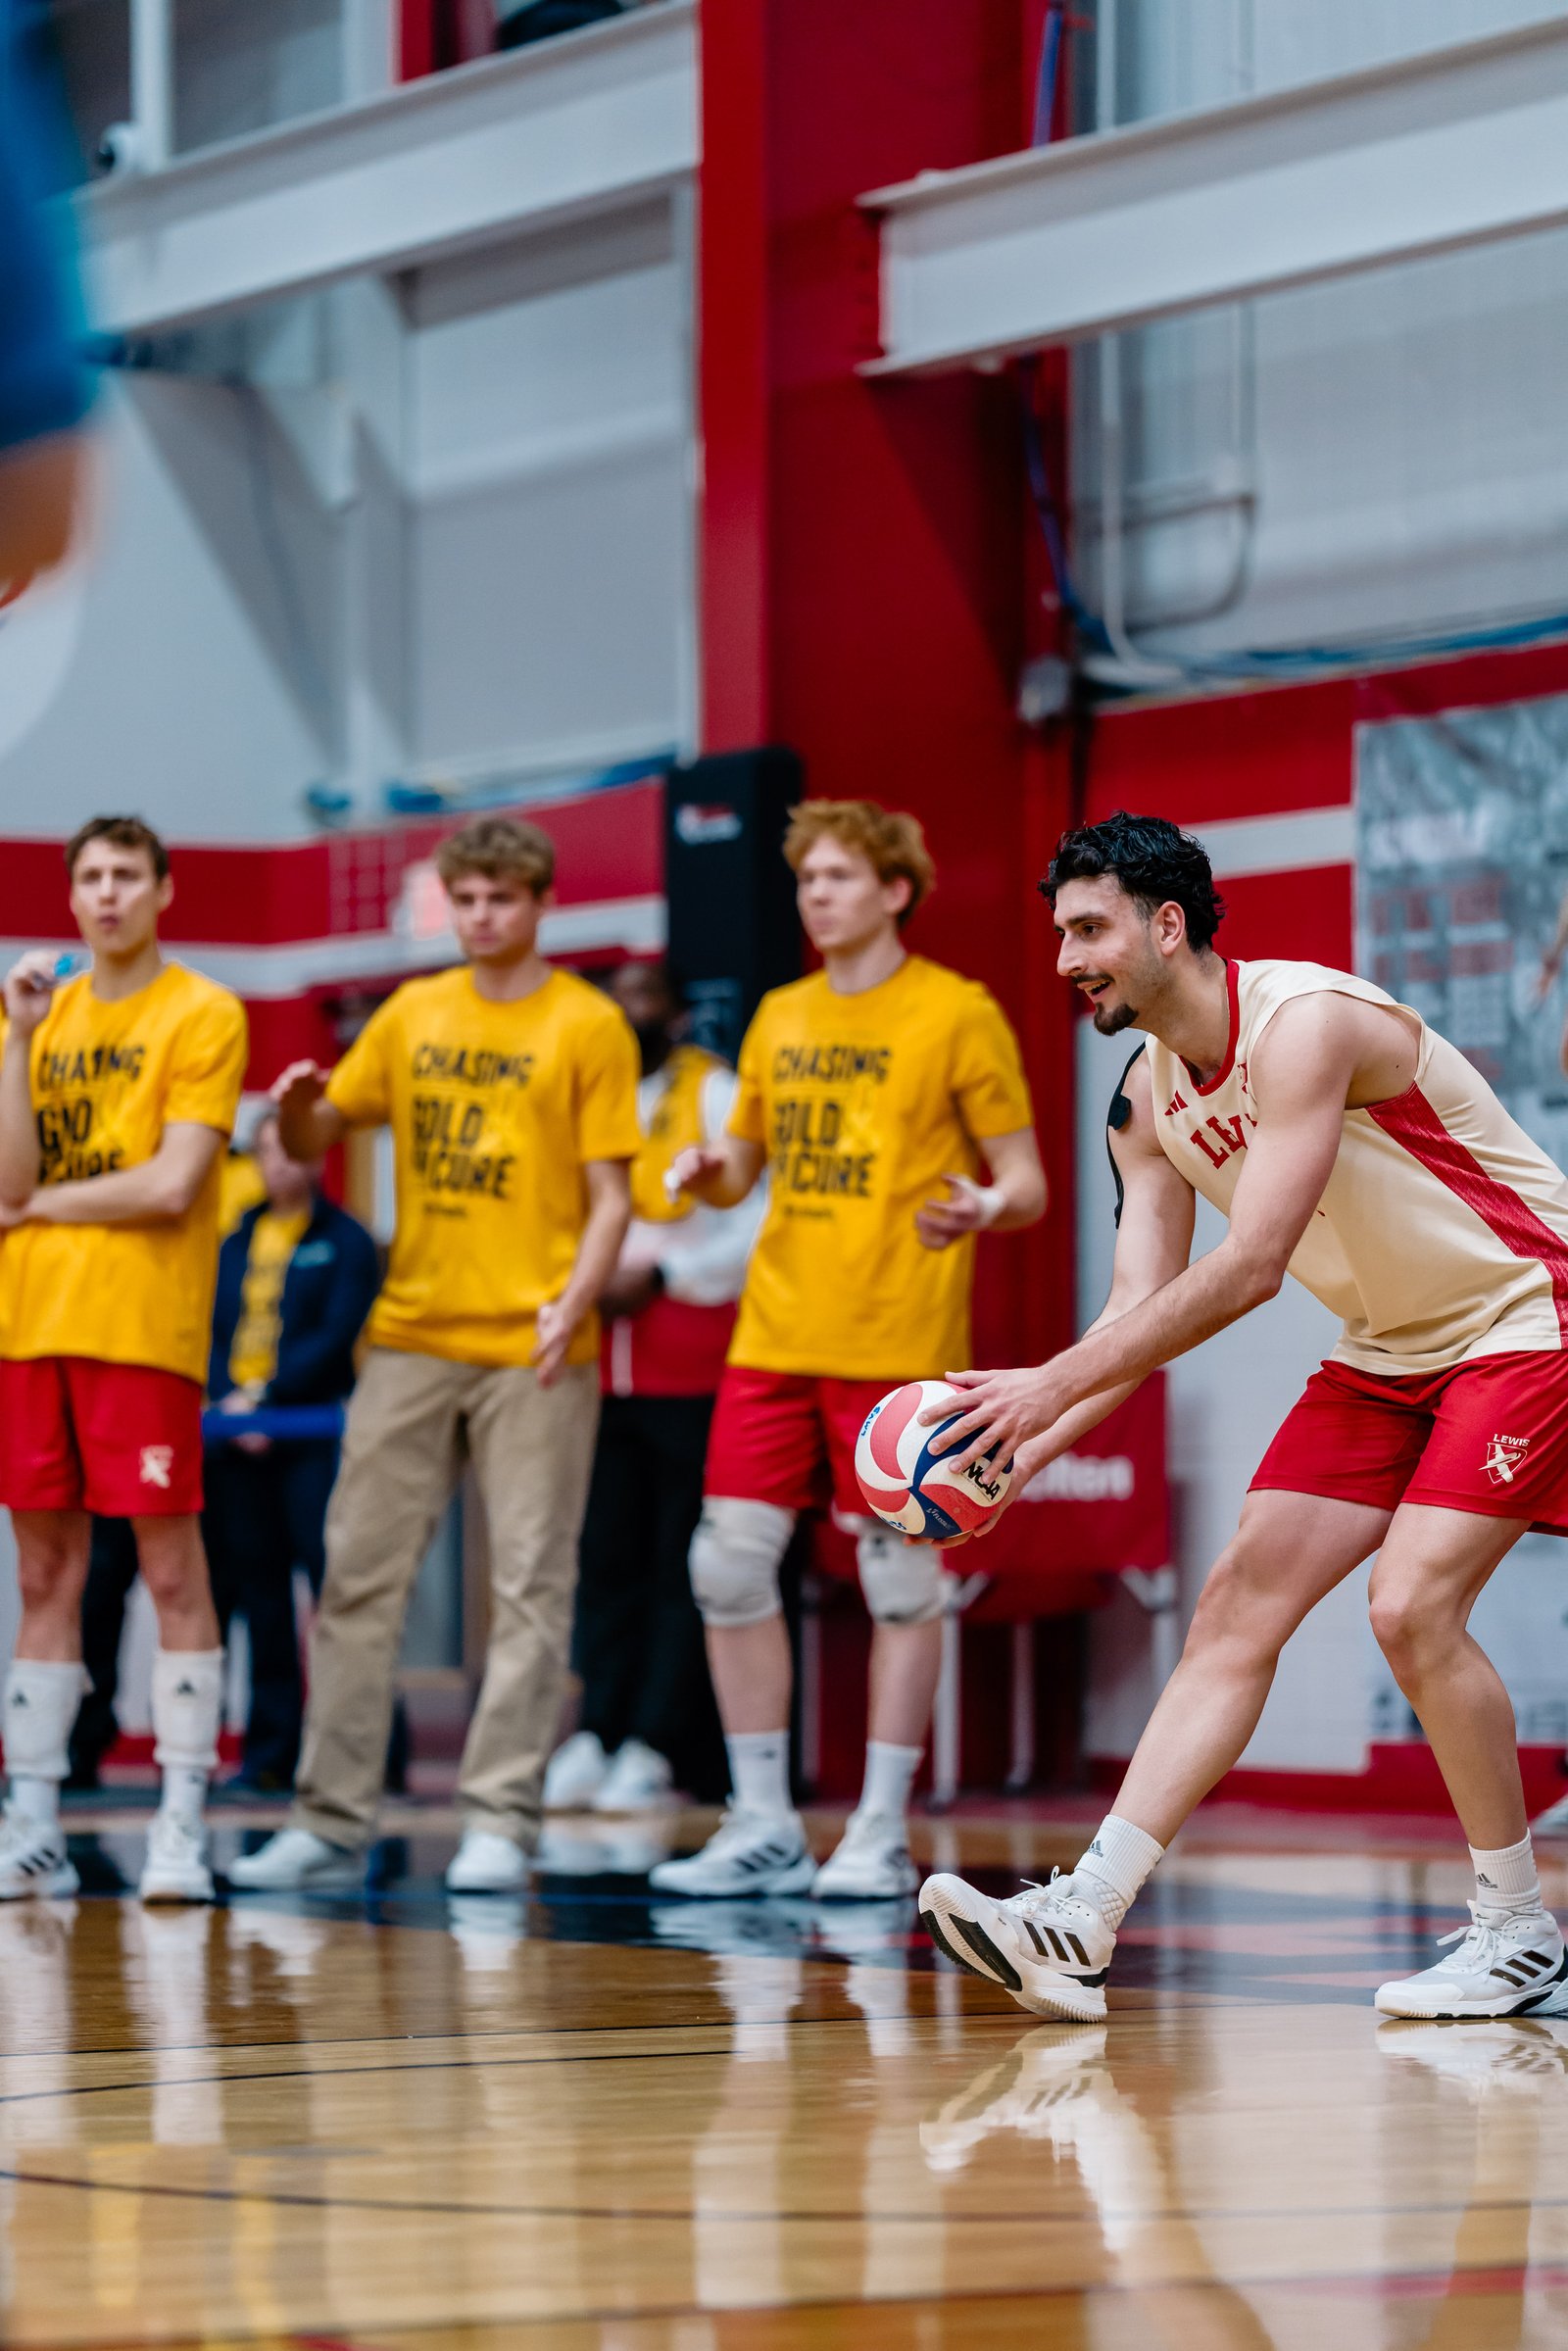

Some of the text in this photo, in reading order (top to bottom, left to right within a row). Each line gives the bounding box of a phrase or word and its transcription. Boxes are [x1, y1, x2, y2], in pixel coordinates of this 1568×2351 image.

[414, 1045, 532, 1087] CHASING
[772, 1046, 891, 1084] CHASING
[430, 1150, 515, 1200] CURE
[791, 1151, 876, 1199] CURE
[1493, 1433, 1531, 1447] LEWIS
